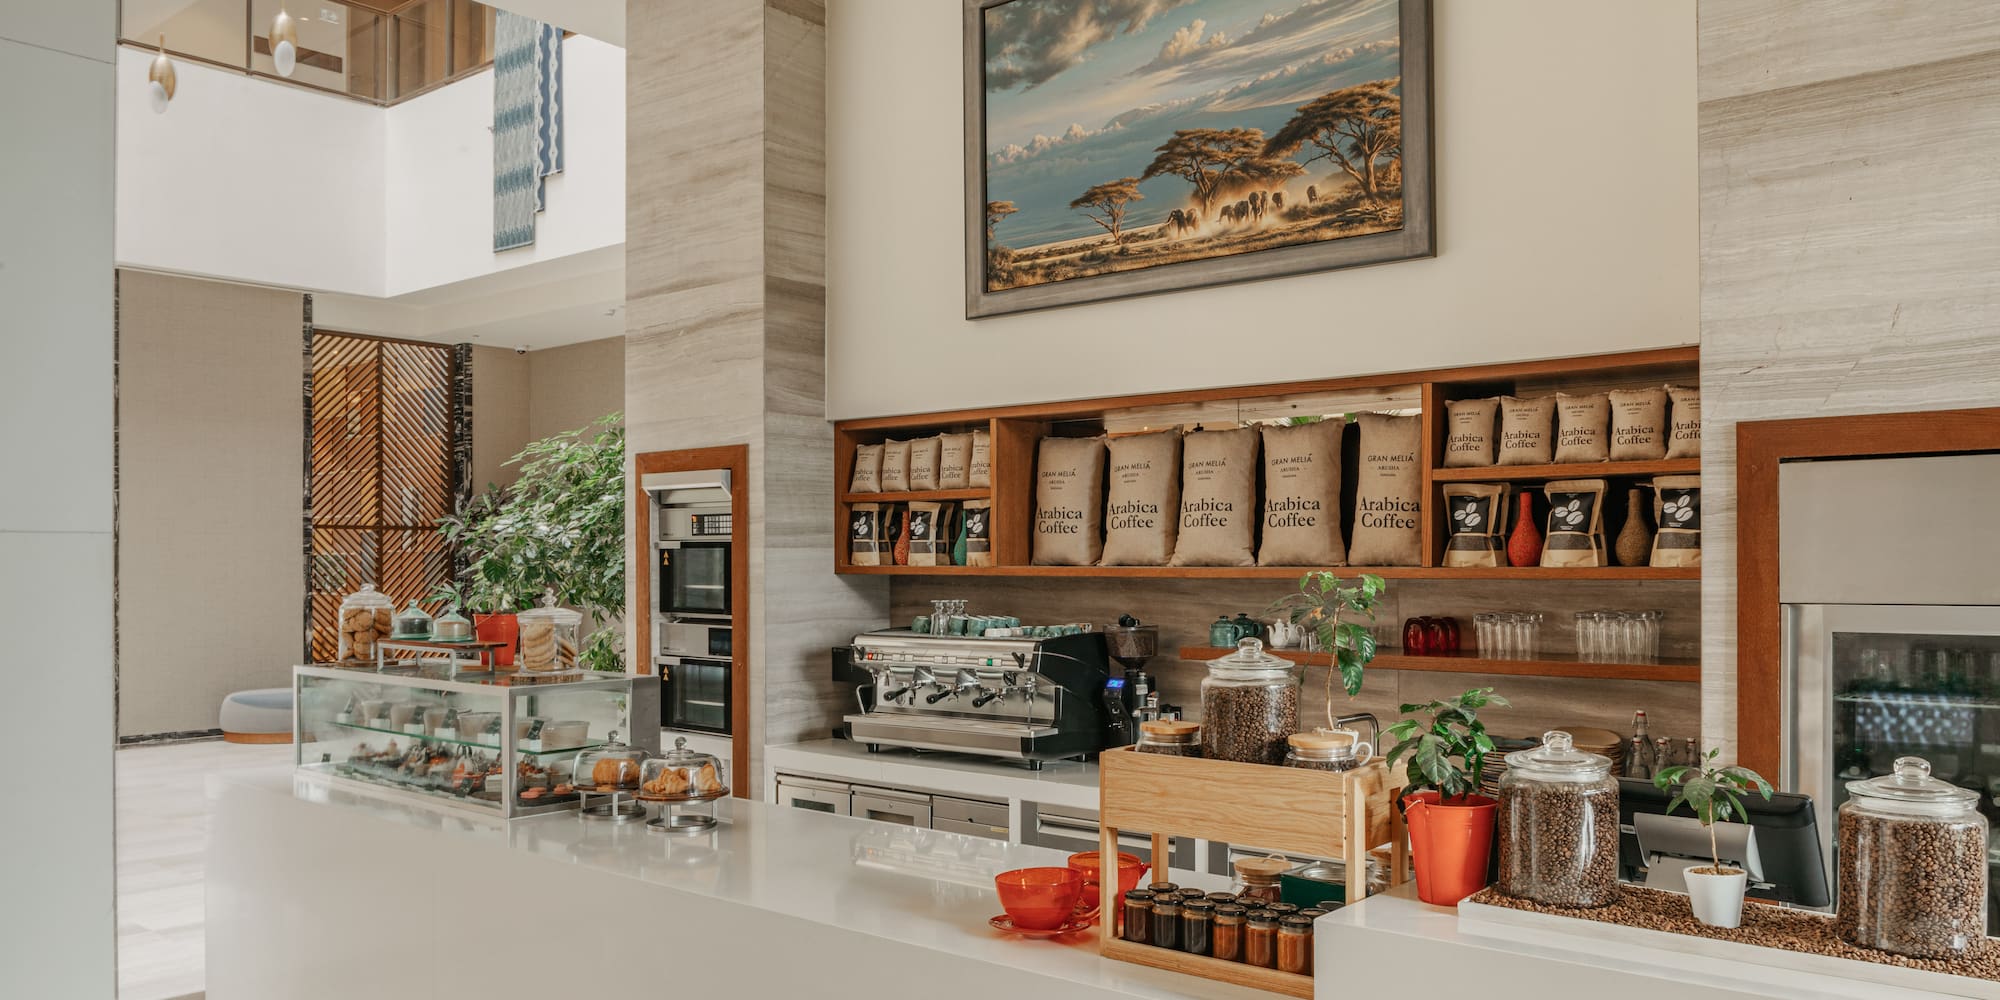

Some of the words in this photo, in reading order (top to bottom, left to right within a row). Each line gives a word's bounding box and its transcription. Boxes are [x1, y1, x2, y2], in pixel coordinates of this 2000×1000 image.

[1615, 425, 1654, 435] Arabica
[1673, 420, 1701, 431] Arabi
[1504, 430, 1540, 439] Arabica
[1560, 426, 1595, 437] Arabica
[1675, 430, 1701, 440] Coff
[1448, 433, 1484, 443] Arabica
[1561, 436, 1593, 446] Coffee
[1617, 435, 1651, 445] Coffee
[1450, 443, 1480, 452] Coffee
[1505, 440, 1537, 448] Coffee
[1272, 458, 1288, 466] GRAN
[1110, 500, 1158, 516] Arabica
[1182, 498, 1232, 513] Arabica
[1266, 496, 1320, 512] Arabica
[1360, 496, 1421, 512] Arabica
[1037, 506, 1083, 519] Arabica
[1111, 514, 1154, 530] Coffee
[1184, 513, 1228, 528] Coffee
[1268, 512, 1316, 528] Coffee
[1361, 512, 1415, 529] Coffee
[1038, 520, 1078, 534] Coffee
